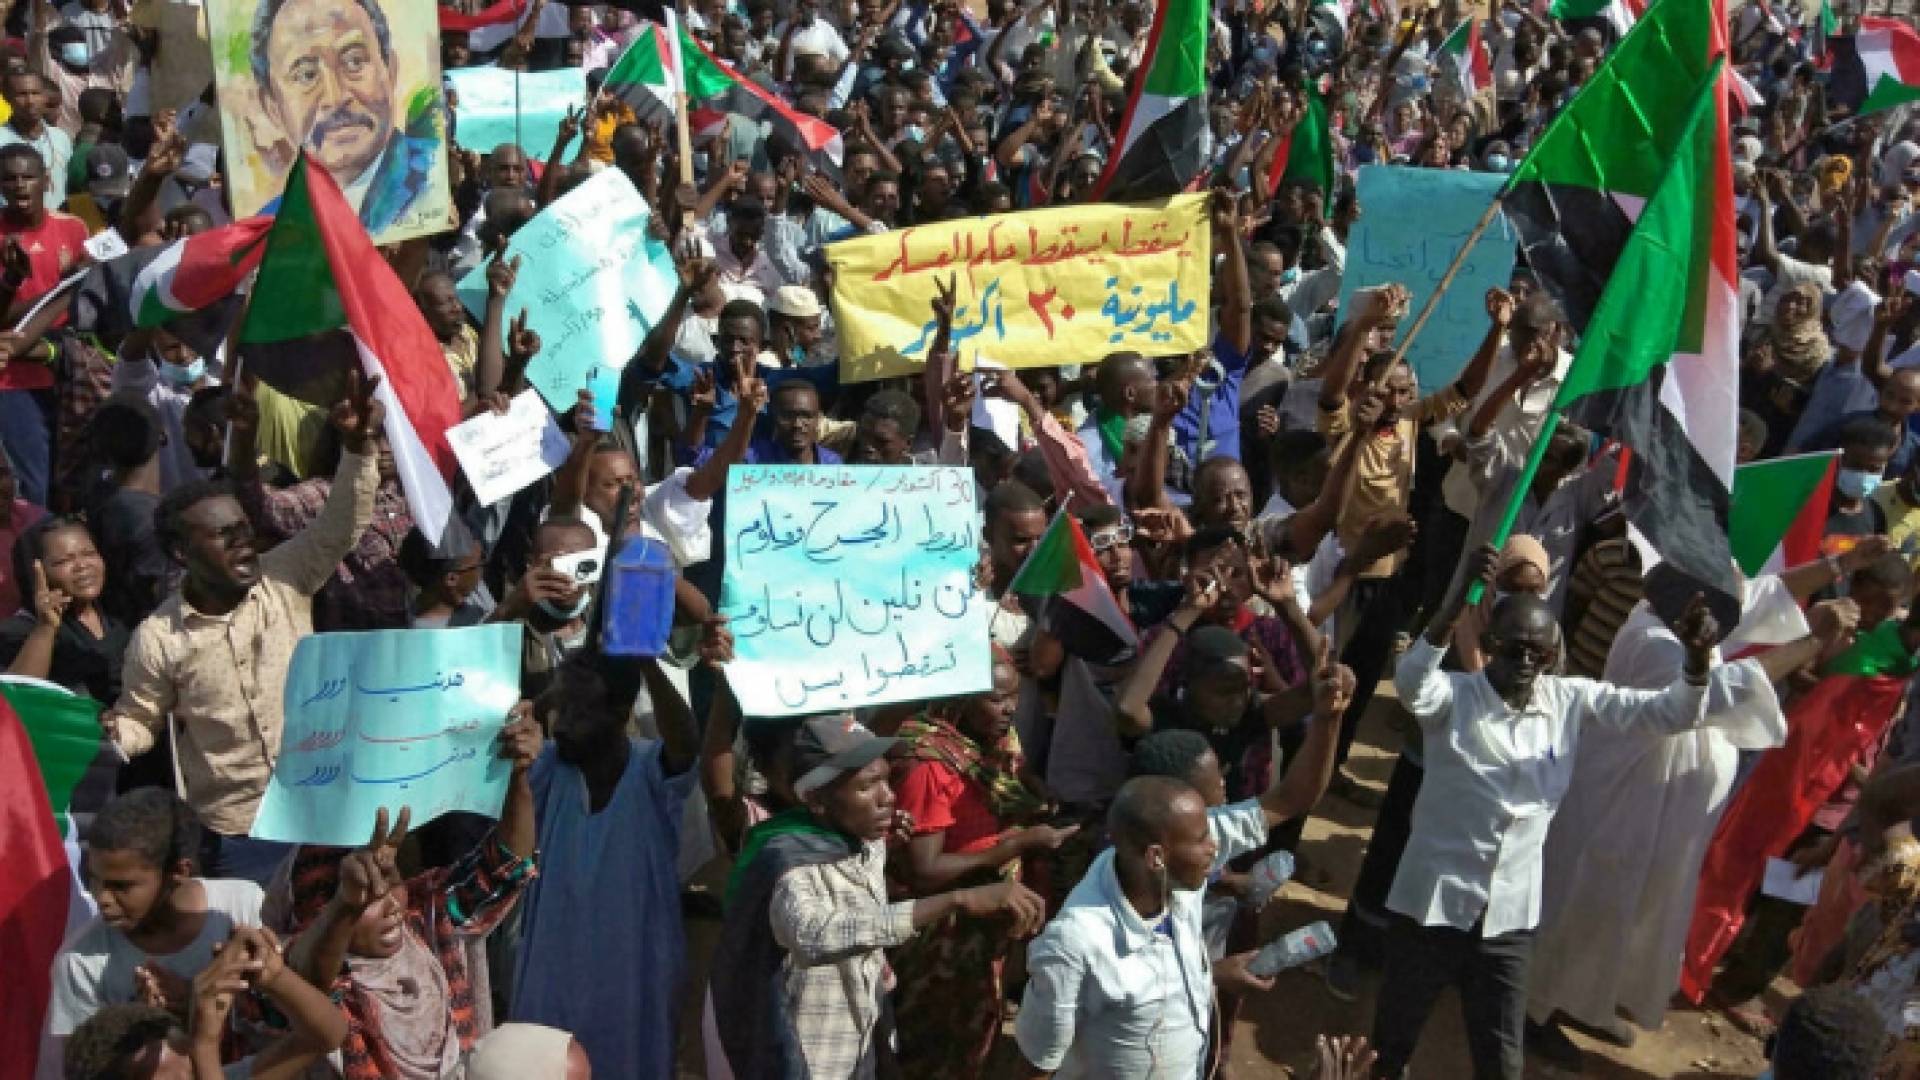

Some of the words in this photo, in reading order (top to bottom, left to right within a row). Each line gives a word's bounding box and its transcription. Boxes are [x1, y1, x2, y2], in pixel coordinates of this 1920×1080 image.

[872, 227, 973, 282] العسكر
[967, 219, 1017, 298] حكم
[1021, 225, 1108, 265] يسقط
[1113, 216, 1192, 257] يسقط
[1101, 276, 1197, 344] مليونية
[806, 578, 843, 648] لن
